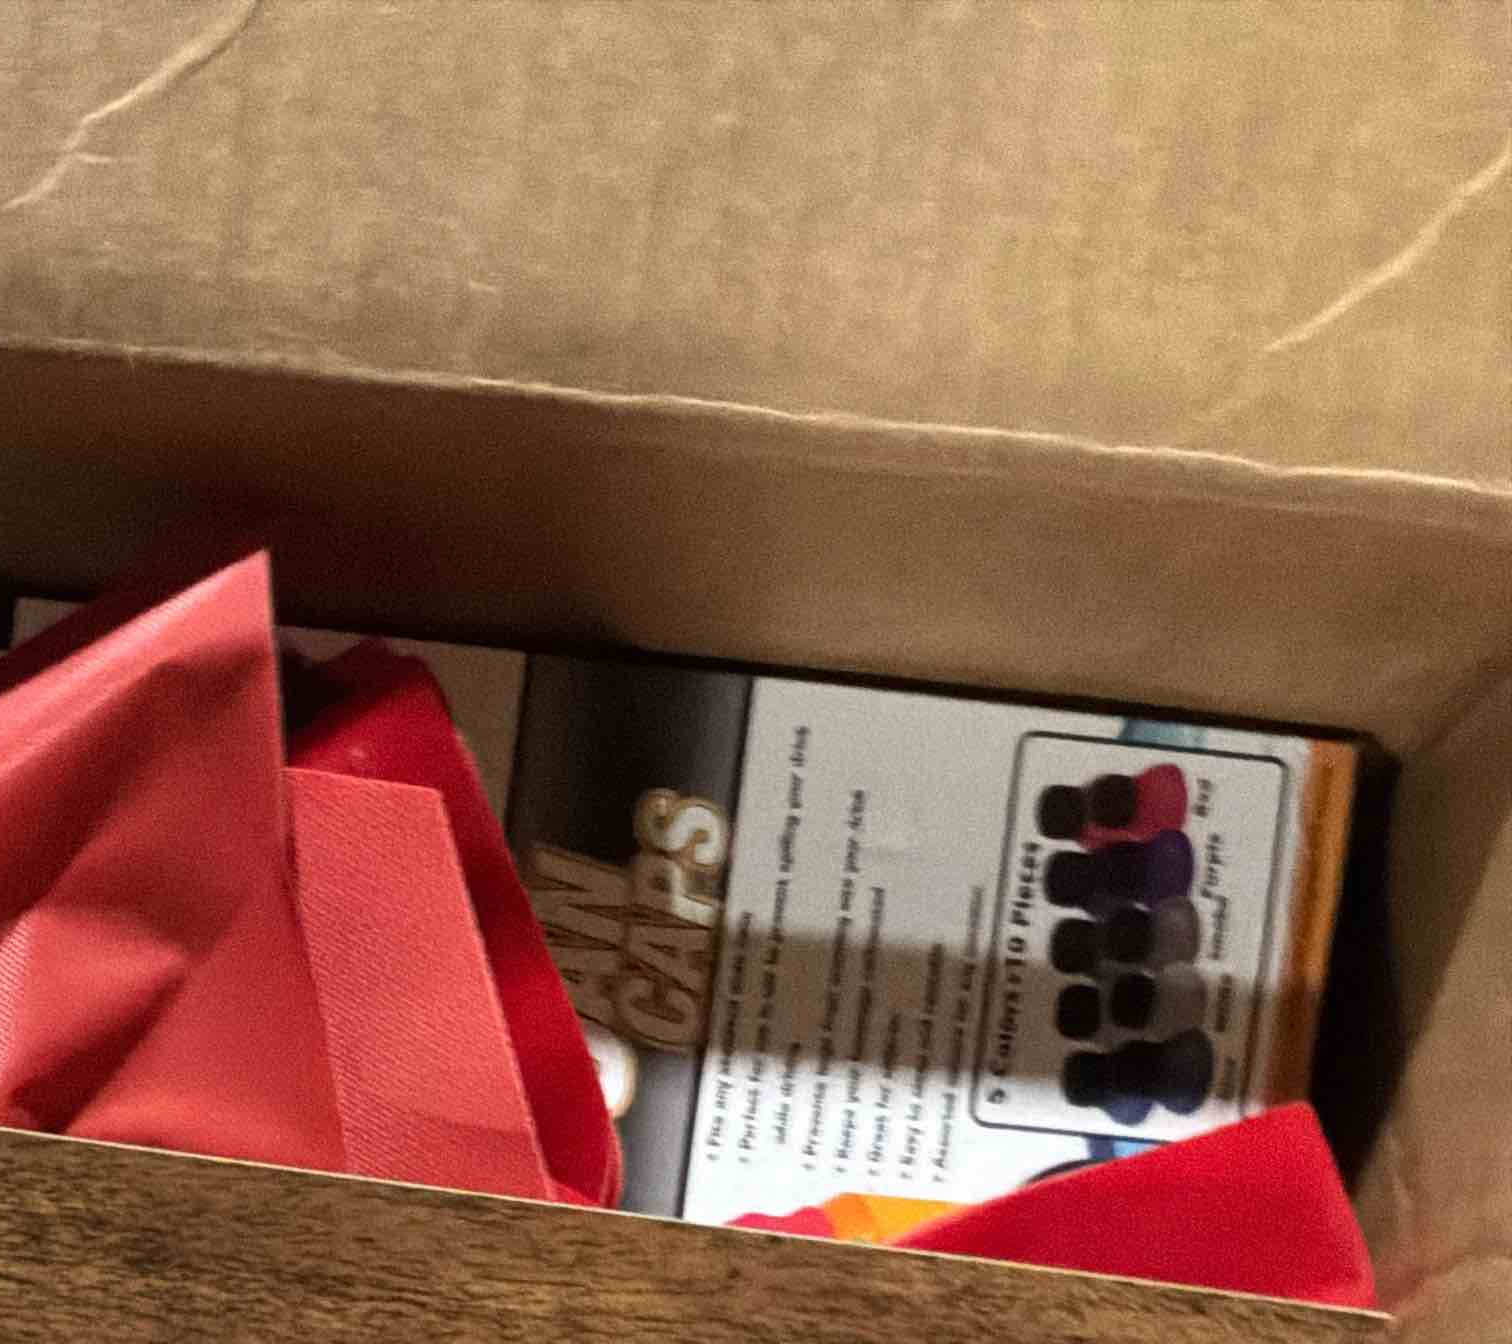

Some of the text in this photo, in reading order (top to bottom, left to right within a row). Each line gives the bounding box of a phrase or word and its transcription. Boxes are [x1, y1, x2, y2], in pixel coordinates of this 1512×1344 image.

[532, 843, 637, 1117] AN
[628, 787, 734, 1050] CAPS
[1010, 840, 1041, 927] Pieces
